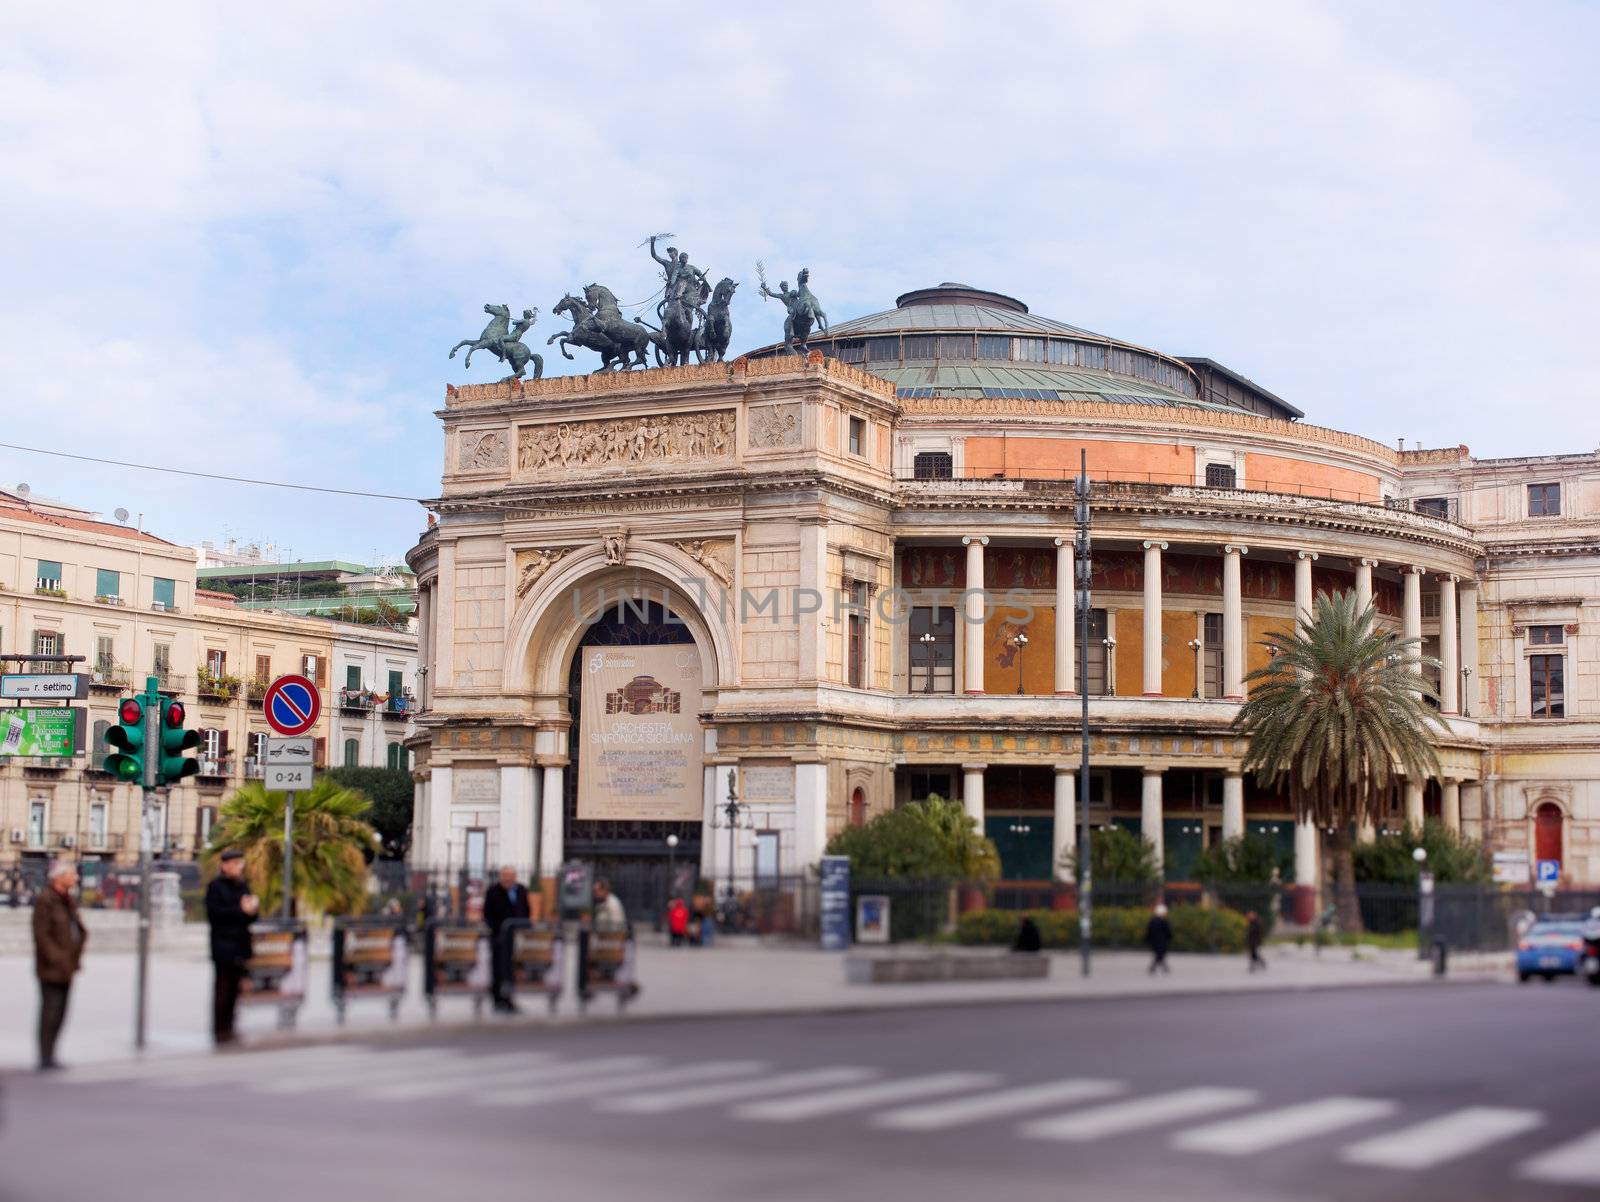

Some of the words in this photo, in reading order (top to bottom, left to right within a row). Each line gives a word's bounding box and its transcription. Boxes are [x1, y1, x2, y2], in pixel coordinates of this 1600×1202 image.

[626, 498, 691, 513] GARIBALDI
[34, 684, 40, 692] r.
[43, 682, 72, 692] settimo
[612, 722, 673, 733] ORCHESTRA
[591, 733, 643, 744] SINFONICA
[645, 733, 695, 744] SICILIANA
[275, 773, 302, 782] 0-24
[1540, 862, 1556, 881] P
